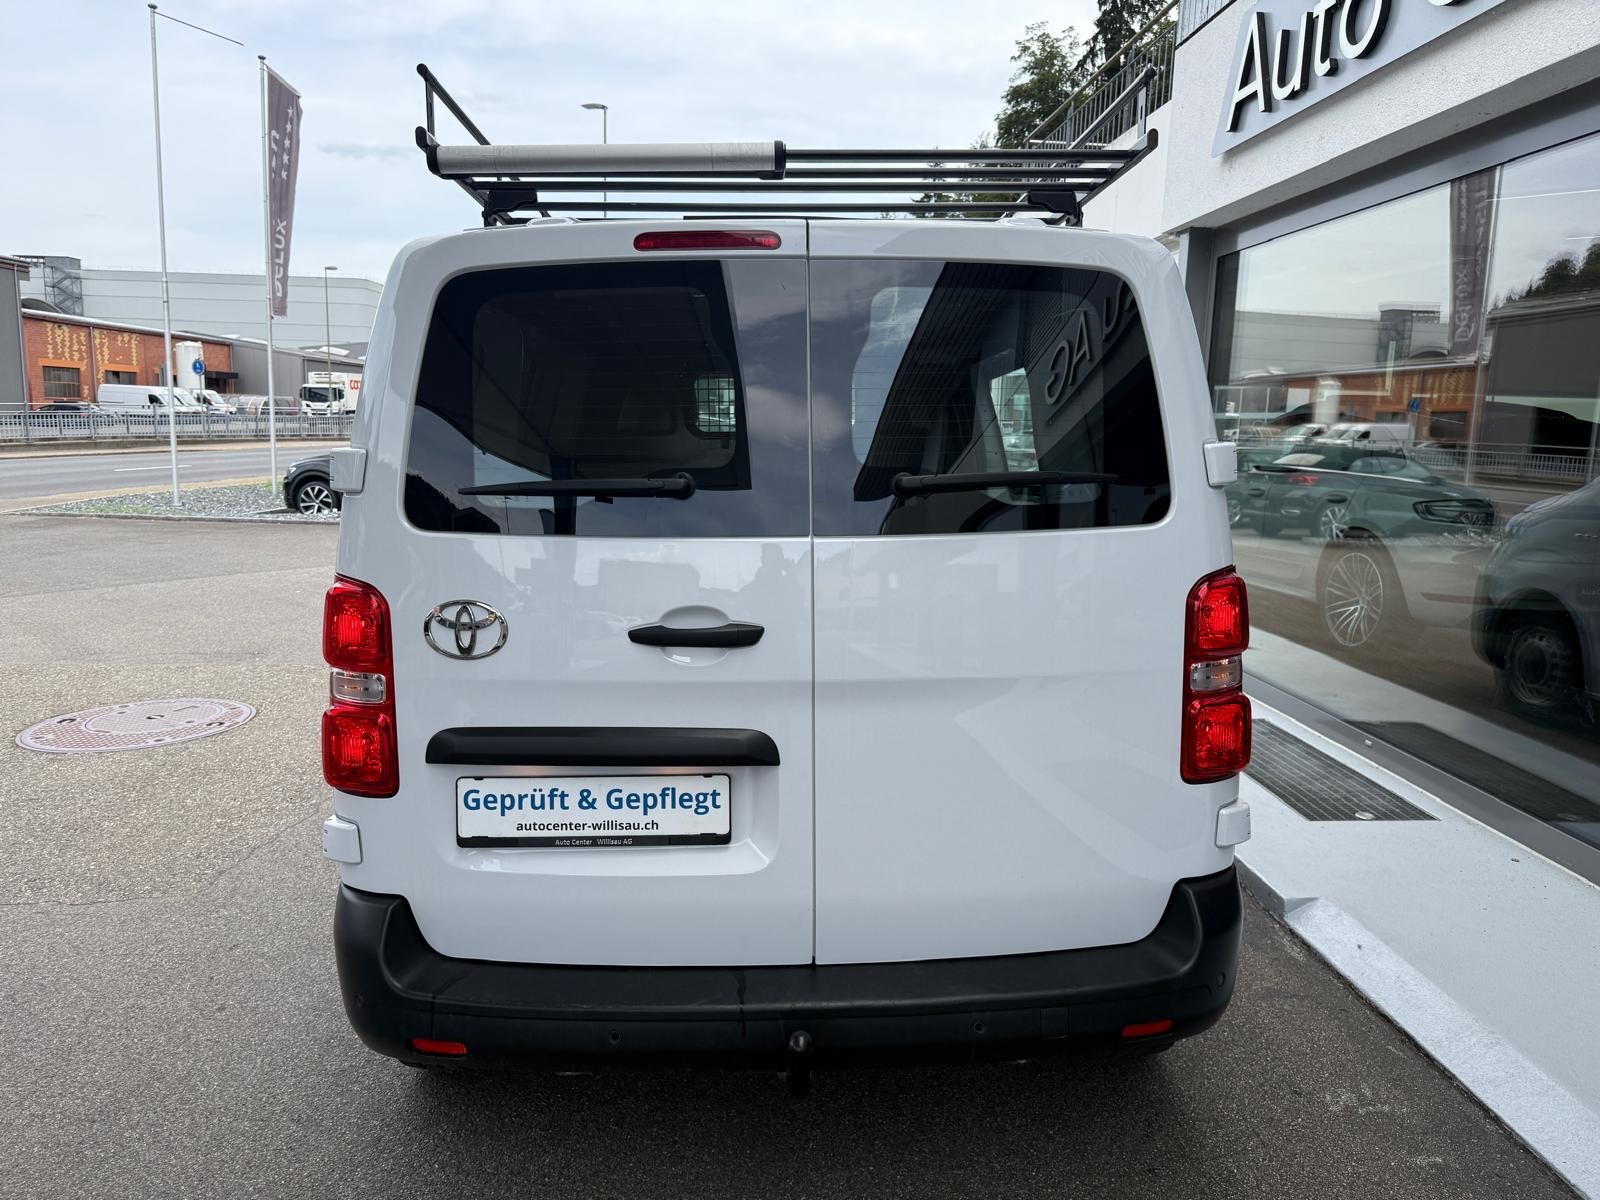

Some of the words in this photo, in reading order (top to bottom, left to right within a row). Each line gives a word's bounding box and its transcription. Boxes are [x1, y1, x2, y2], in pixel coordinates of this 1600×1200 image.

[1225, 0, 1391, 132] Auto
[463, 787, 570, 817] Geprüft
[577, 788, 599, 811] &
[606, 786, 722, 816] Gepflegt
[516, 820, 660, 832] autocenter-willisau.ch
